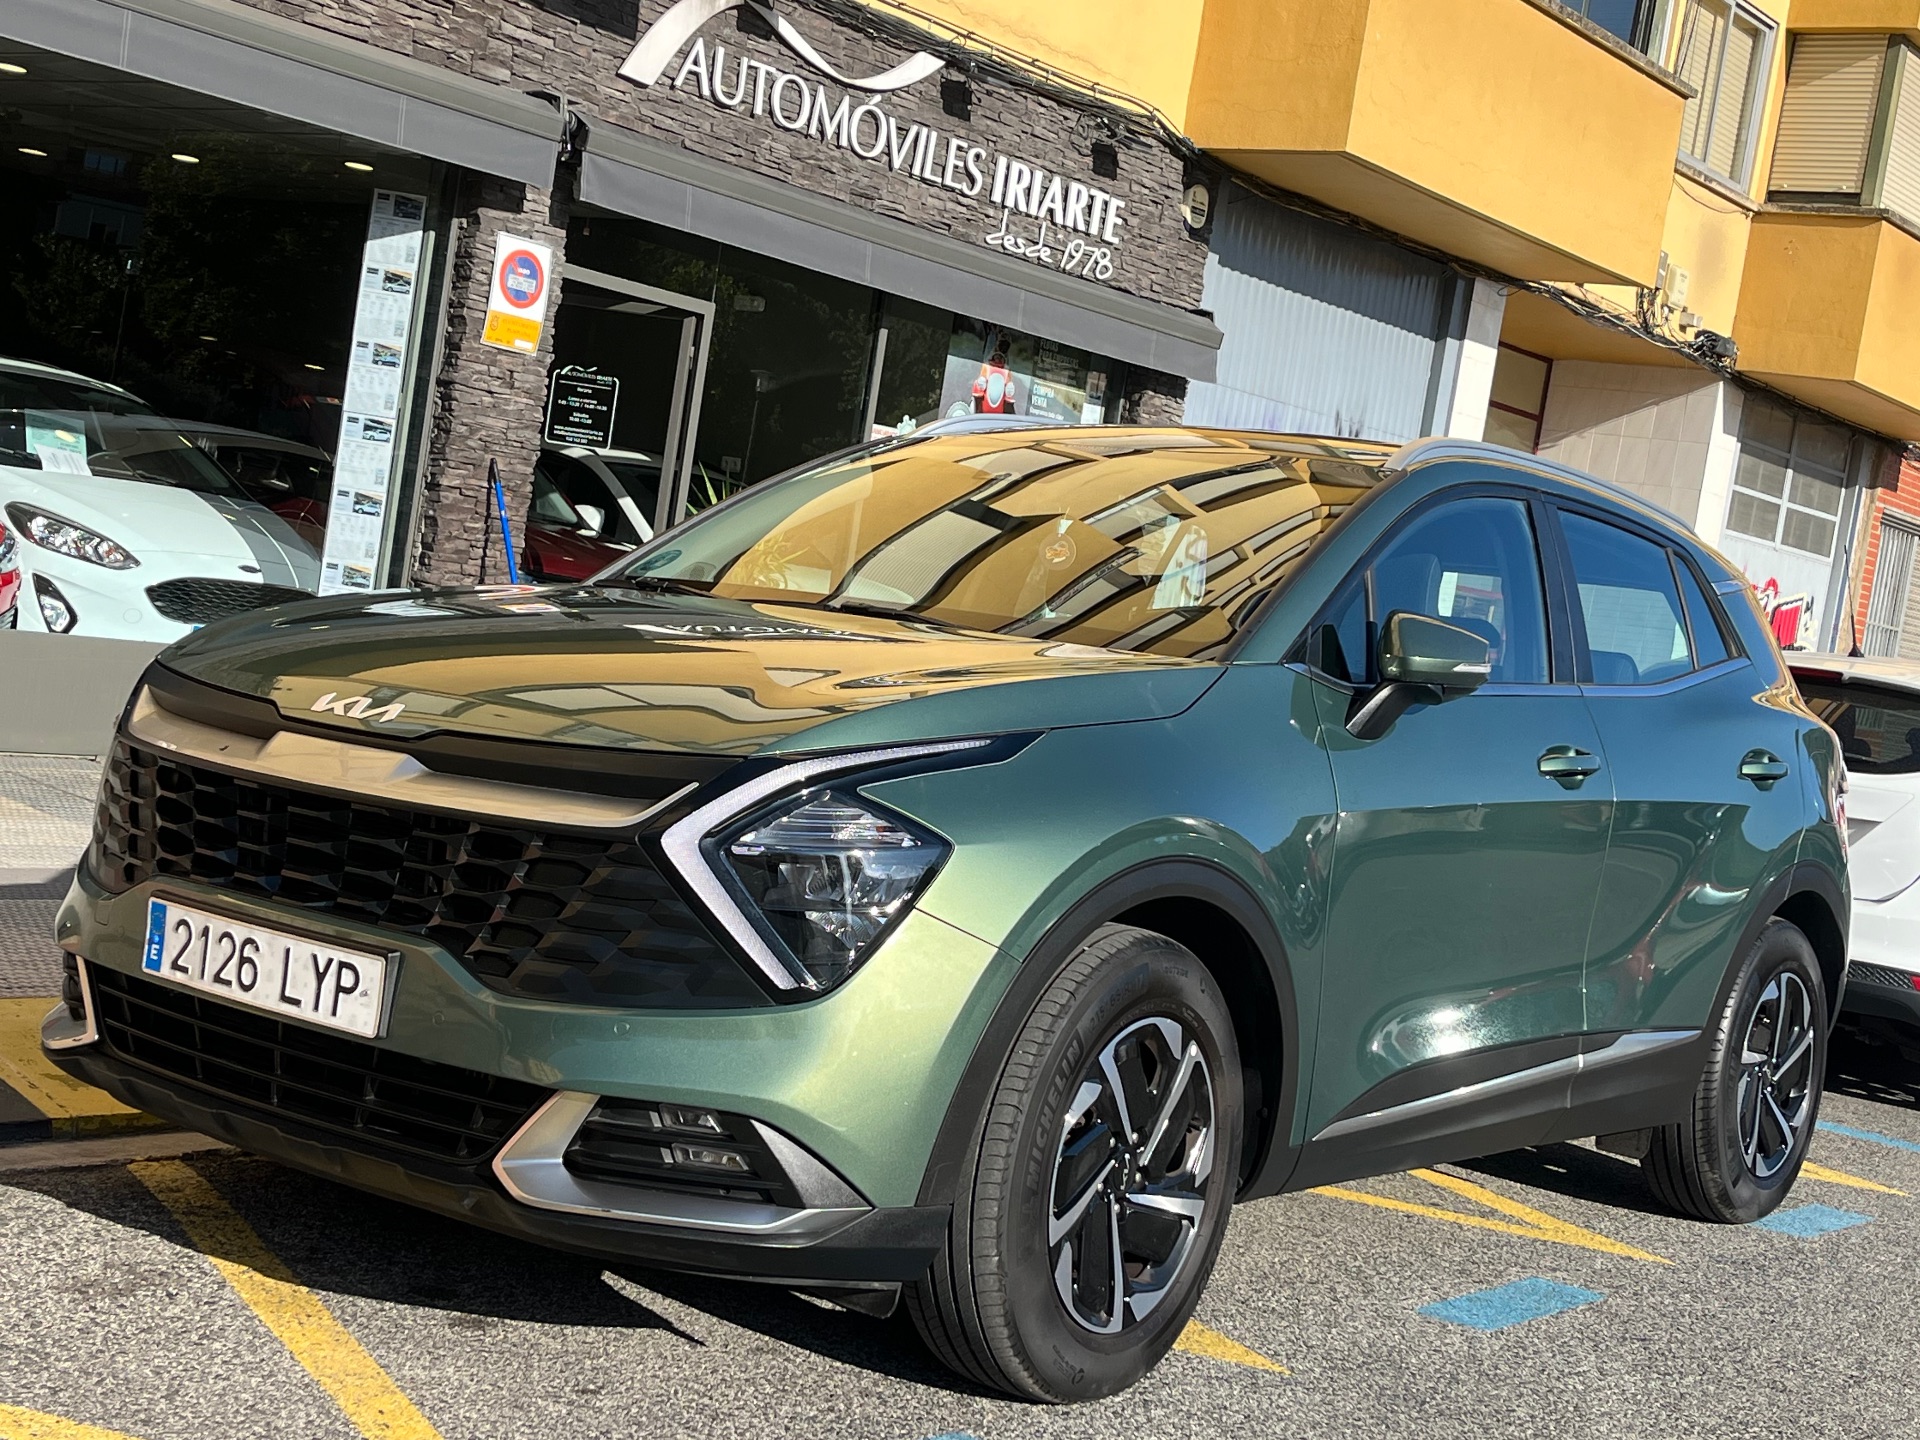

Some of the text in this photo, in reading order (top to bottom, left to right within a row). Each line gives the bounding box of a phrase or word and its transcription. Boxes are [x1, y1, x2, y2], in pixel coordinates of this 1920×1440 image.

[673, 37, 1126, 245] AUTOMÓVILES IRIARTE
[985, 208, 1113, 279] desde 1978
[1031, 394, 1048, 408] VENTA
[1033, 383, 1055, 398] COMPRA
[310, 692, 406, 723] KIA
[150, 945, 159, 960] E
[170, 918, 361, 1017] 2126 LYP
[1026, 1038, 1083, 1191] MICHELIN
